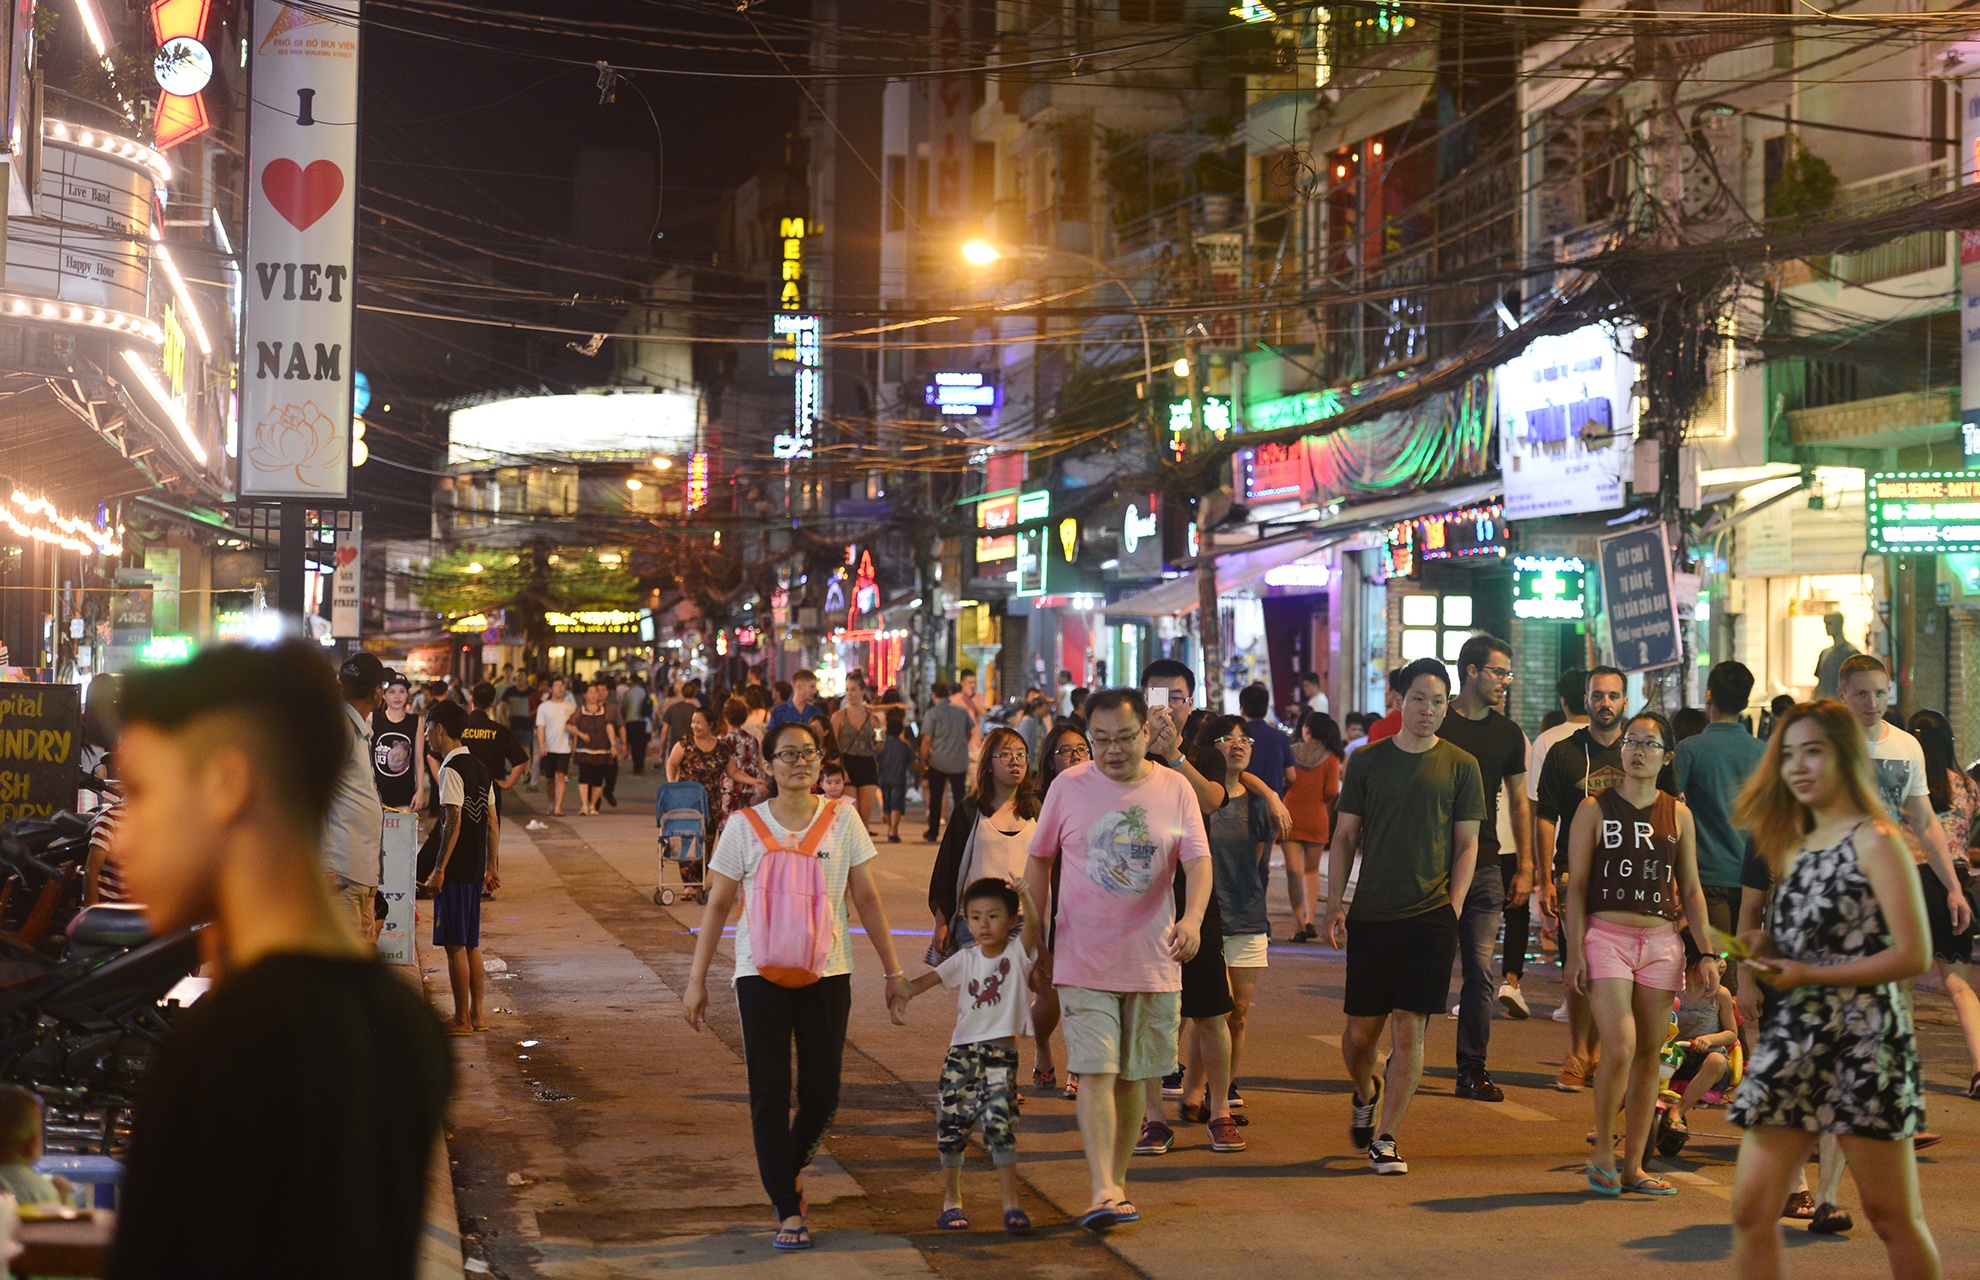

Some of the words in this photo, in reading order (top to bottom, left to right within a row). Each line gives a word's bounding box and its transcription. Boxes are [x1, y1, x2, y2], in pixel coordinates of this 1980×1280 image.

[296, 87, 316, 126] I
[68, 183, 87, 198] Live
[91, 188, 111, 204] Band
[65, 255, 92, 275] Happy
[96, 262, 115, 278] Hour
[255, 262, 347, 303] VIET
[256, 341, 342, 382] NAM
[117, 612, 147, 624] ANZ
